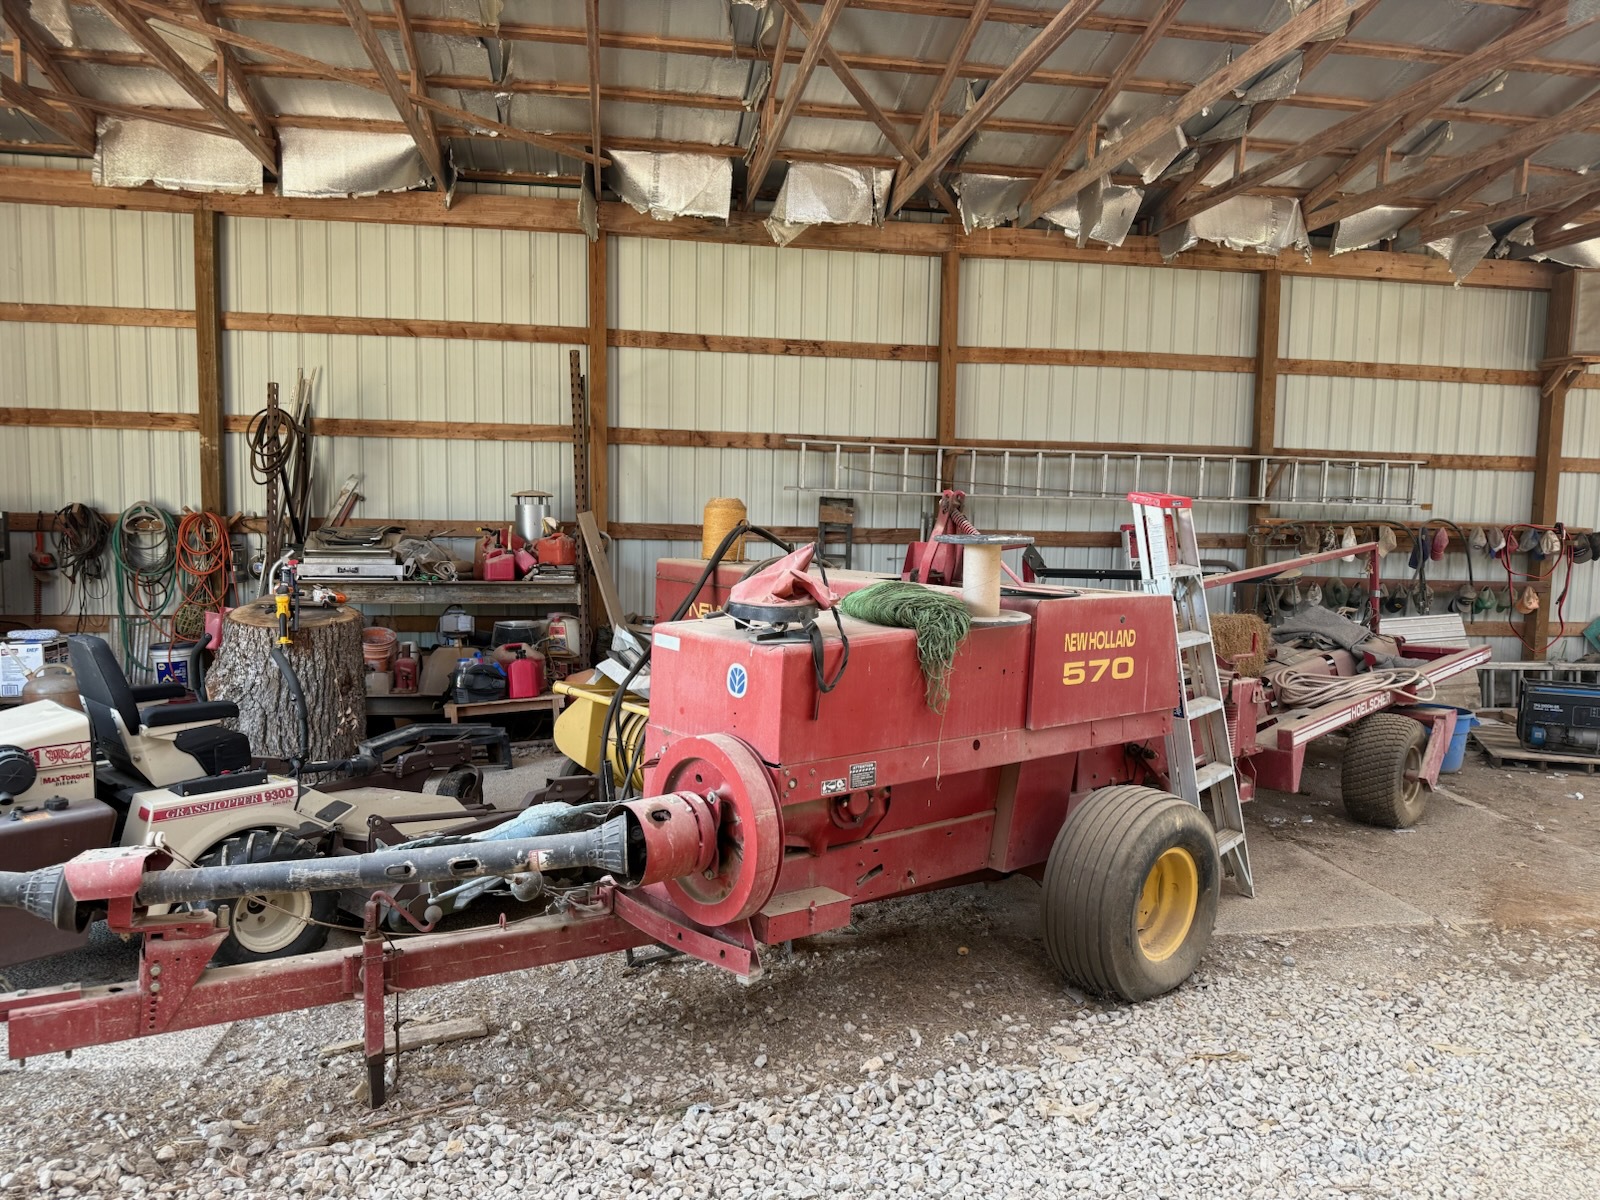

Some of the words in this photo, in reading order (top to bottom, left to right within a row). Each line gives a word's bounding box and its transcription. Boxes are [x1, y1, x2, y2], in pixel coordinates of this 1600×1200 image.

[1064, 631, 1088, 652] NEW
[1088, 629, 1136, 650] HOLLAND
[1062, 656, 1135, 686] 570
[1351, 691, 1391, 720] HOELSCHER
[165, 794, 260, 818] GRASSHOPPER
[264, 786, 295, 801] 930D
